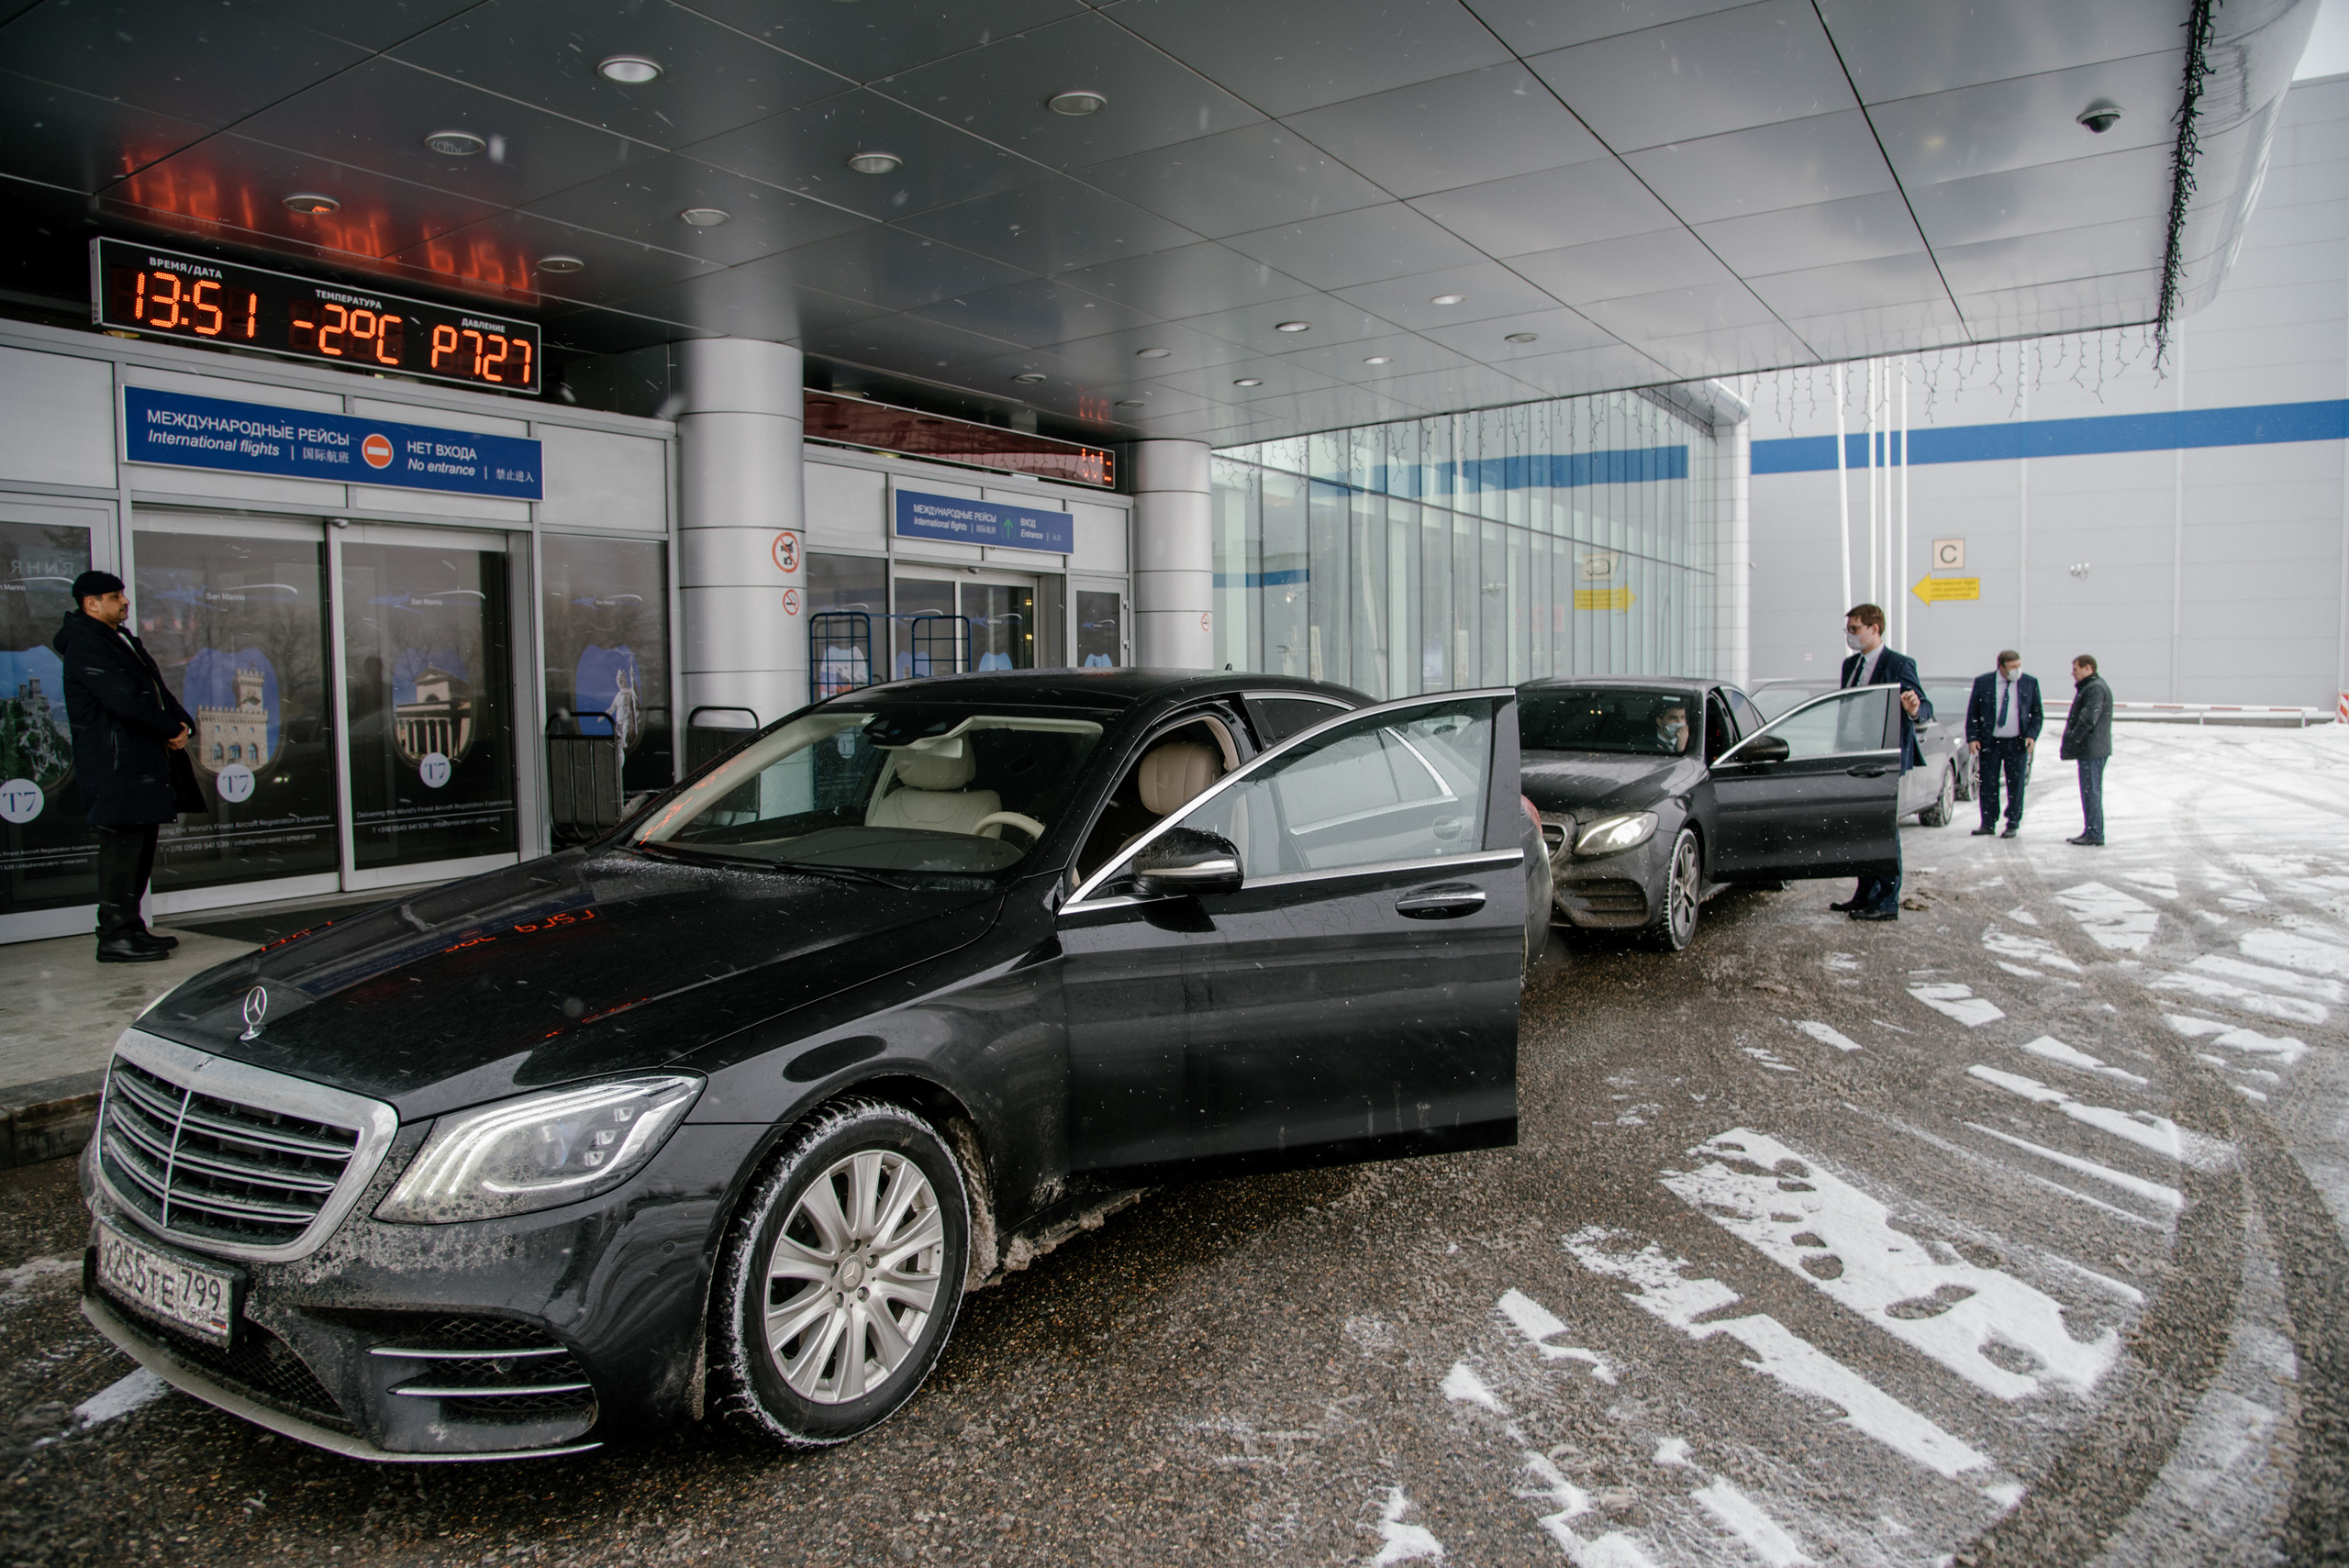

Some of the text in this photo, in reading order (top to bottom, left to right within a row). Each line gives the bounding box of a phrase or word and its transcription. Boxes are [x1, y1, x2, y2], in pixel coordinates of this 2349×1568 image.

[149, 256, 223, 279] ВРЕМЯ/ДАТА
[135, 272, 257, 339] 13:51
[315, 288, 383, 310] ТЕМПЕРАТУРА
[461, 317, 506, 333] ДАВЛЕНИЕ
[147, 409, 351, 447] МЕЖДУНАРОДНЫЕ РЕЙСЫ
[148, 429, 280, 457] International flights
[406, 440, 478, 461] НЕТ ВХОДА
[302, 447, 351, 463] 国际航班
[407, 458, 476, 476] No entrance
[495, 468, 535, 483] 禁止进入
[913, 504, 997, 523] МЕЖДУНАРОДНЫЕ РЕЙСЫ
[913, 516, 968, 531] International flights
[1019, 517, 1037, 529] ВХОД
[1020, 528, 1044, 539] Entrance
[4, 584, 27, 592] Marino
[206, 592, 246, 601] San Marino
[425, 762, 447, 779] T7
[222, 774, 250, 794] T7
[3, 791, 37, 812] T7
[356, 810, 385, 818] Delivering
[188, 824, 213, 832] World's
[235, 819, 259, 828] Aircraft
[259, 817, 295, 828] Registration
[296, 815, 330, 824] Experience
[184, 843, 203, 851] 0549
[181, 1267, 222, 1312] 799
